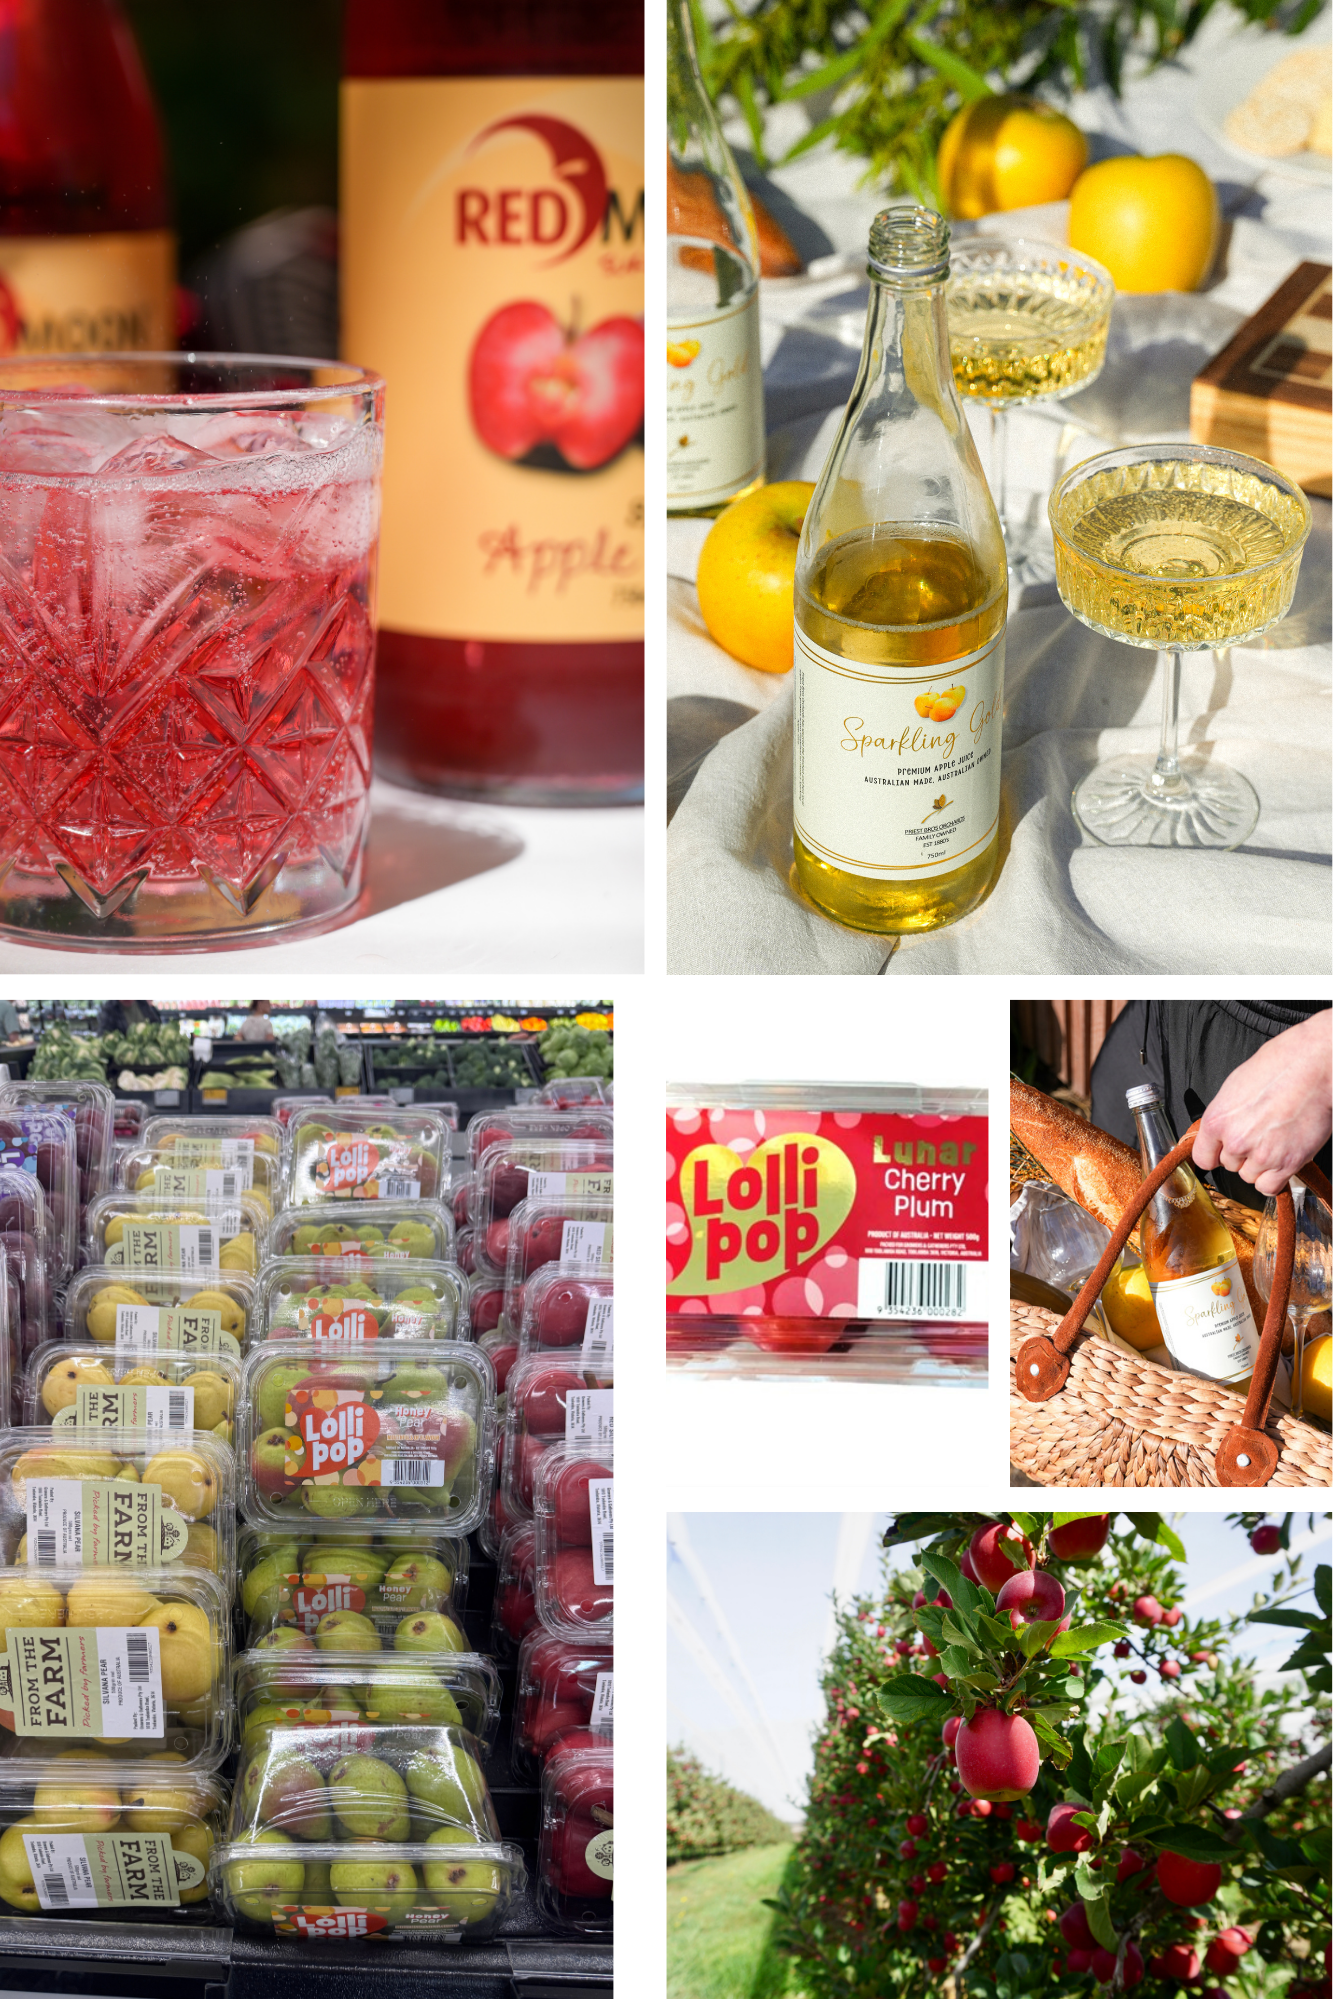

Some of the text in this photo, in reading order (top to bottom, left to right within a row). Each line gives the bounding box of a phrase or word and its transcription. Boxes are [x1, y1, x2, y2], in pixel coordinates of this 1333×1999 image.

[457, 188, 569, 246] RED
[477, 522, 638, 597] Apple
[841, 716, 960, 759] Sparkling
[864, 775, 910, 786] AUSTRALIAN
[937, 761, 975, 782] AUSTRALIAN
[897, 751, 974, 776] PREMIUM APPLE JUICE
[915, 827, 957, 842] FAMILY OWNED
[924, 825, 939, 833] BROS
[330, 1144, 369, 1167] Lolli
[873, 1135, 977, 1166] Lunar
[334, 1165, 368, 1187] pop
[694, 1143, 819, 1216] Lolli
[884, 1168, 966, 1196] Cherry
[894, 1196, 954, 1219] Plum
[133, 1230, 141, 1256] THE
[706, 1207, 819, 1281] pop
[900, 1231, 929, 1239] AUSTRALIA
[877, 1306, 962, 1316] 9 354236 000282
[1184, 1301, 1235, 1327] Sparkling
[315, 1312, 365, 1340] Lolli
[89, 1391, 99, 1421] THE
[130, 1392, 138, 1425] farmers
[395, 1406, 431, 1419] Honey
[305, 1405, 364, 1442] Lolli
[312, 1435, 364, 1471] pop
[92, 1489, 101, 1525] Picked
[137, 1493, 148, 1565] FROM TH
[297, 1585, 351, 1613] Lolli
[379, 1585, 412, 1594] Honey
[383, 1593, 407, 1602] Pear
[23, 1636, 42, 1727] FROM THE
[39, 1637, 67, 1727] FARM
[78, 1636, 92, 1728] Picked by farmers
[100, 1659, 110, 1705] SILVANA PEAR
[95, 1840, 107, 1865] Picked
[103, 1873, 114, 1902] farmers
[119, 1840, 149, 1901] FARM
[144, 1840, 165, 1901] FROM THE
[297, 1914, 368, 1928] Lolli
[307, 1926, 368, 1938] pop
